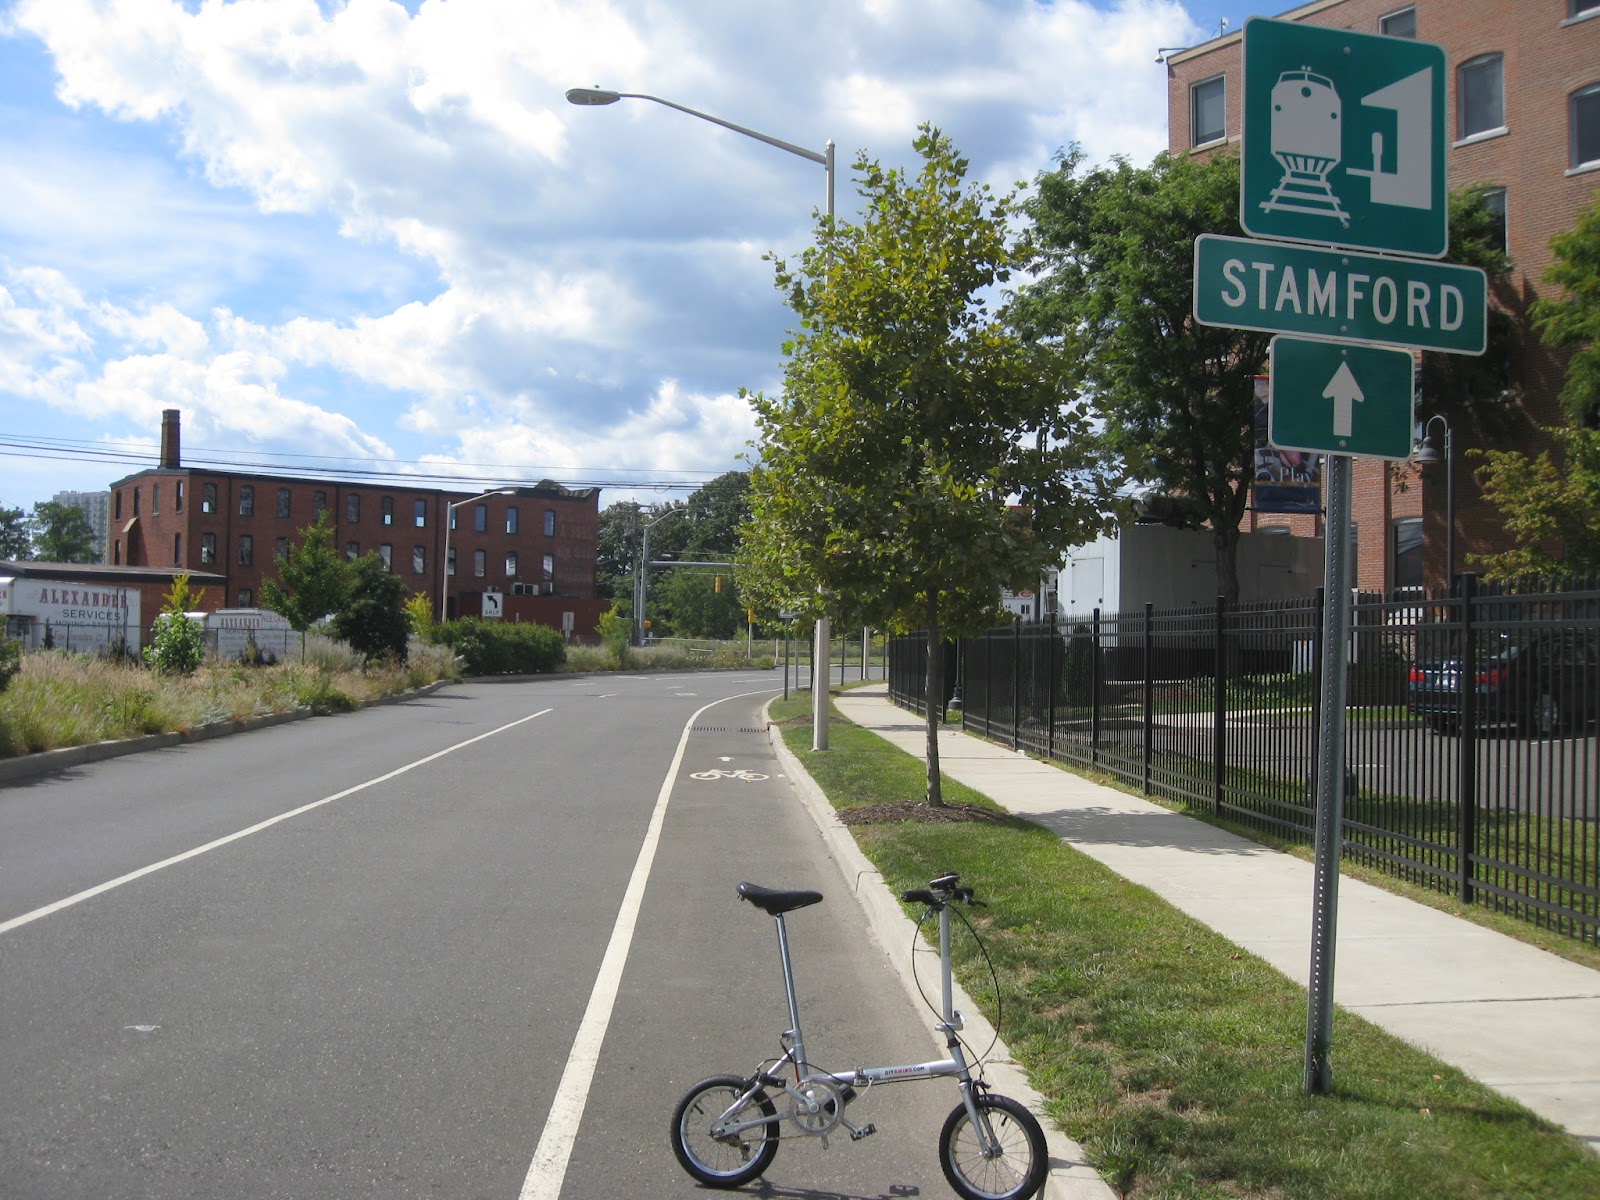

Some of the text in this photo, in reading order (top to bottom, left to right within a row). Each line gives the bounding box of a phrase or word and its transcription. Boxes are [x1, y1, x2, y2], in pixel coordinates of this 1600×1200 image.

[1221, 258, 1464, 331] STAMFORD
[1280, 467, 1313, 488] Play
[39, 588, 127, 609] ALEXANDER
[55, 620, 84, 628] MOVING
[62, 609, 121, 621] SERVICES
